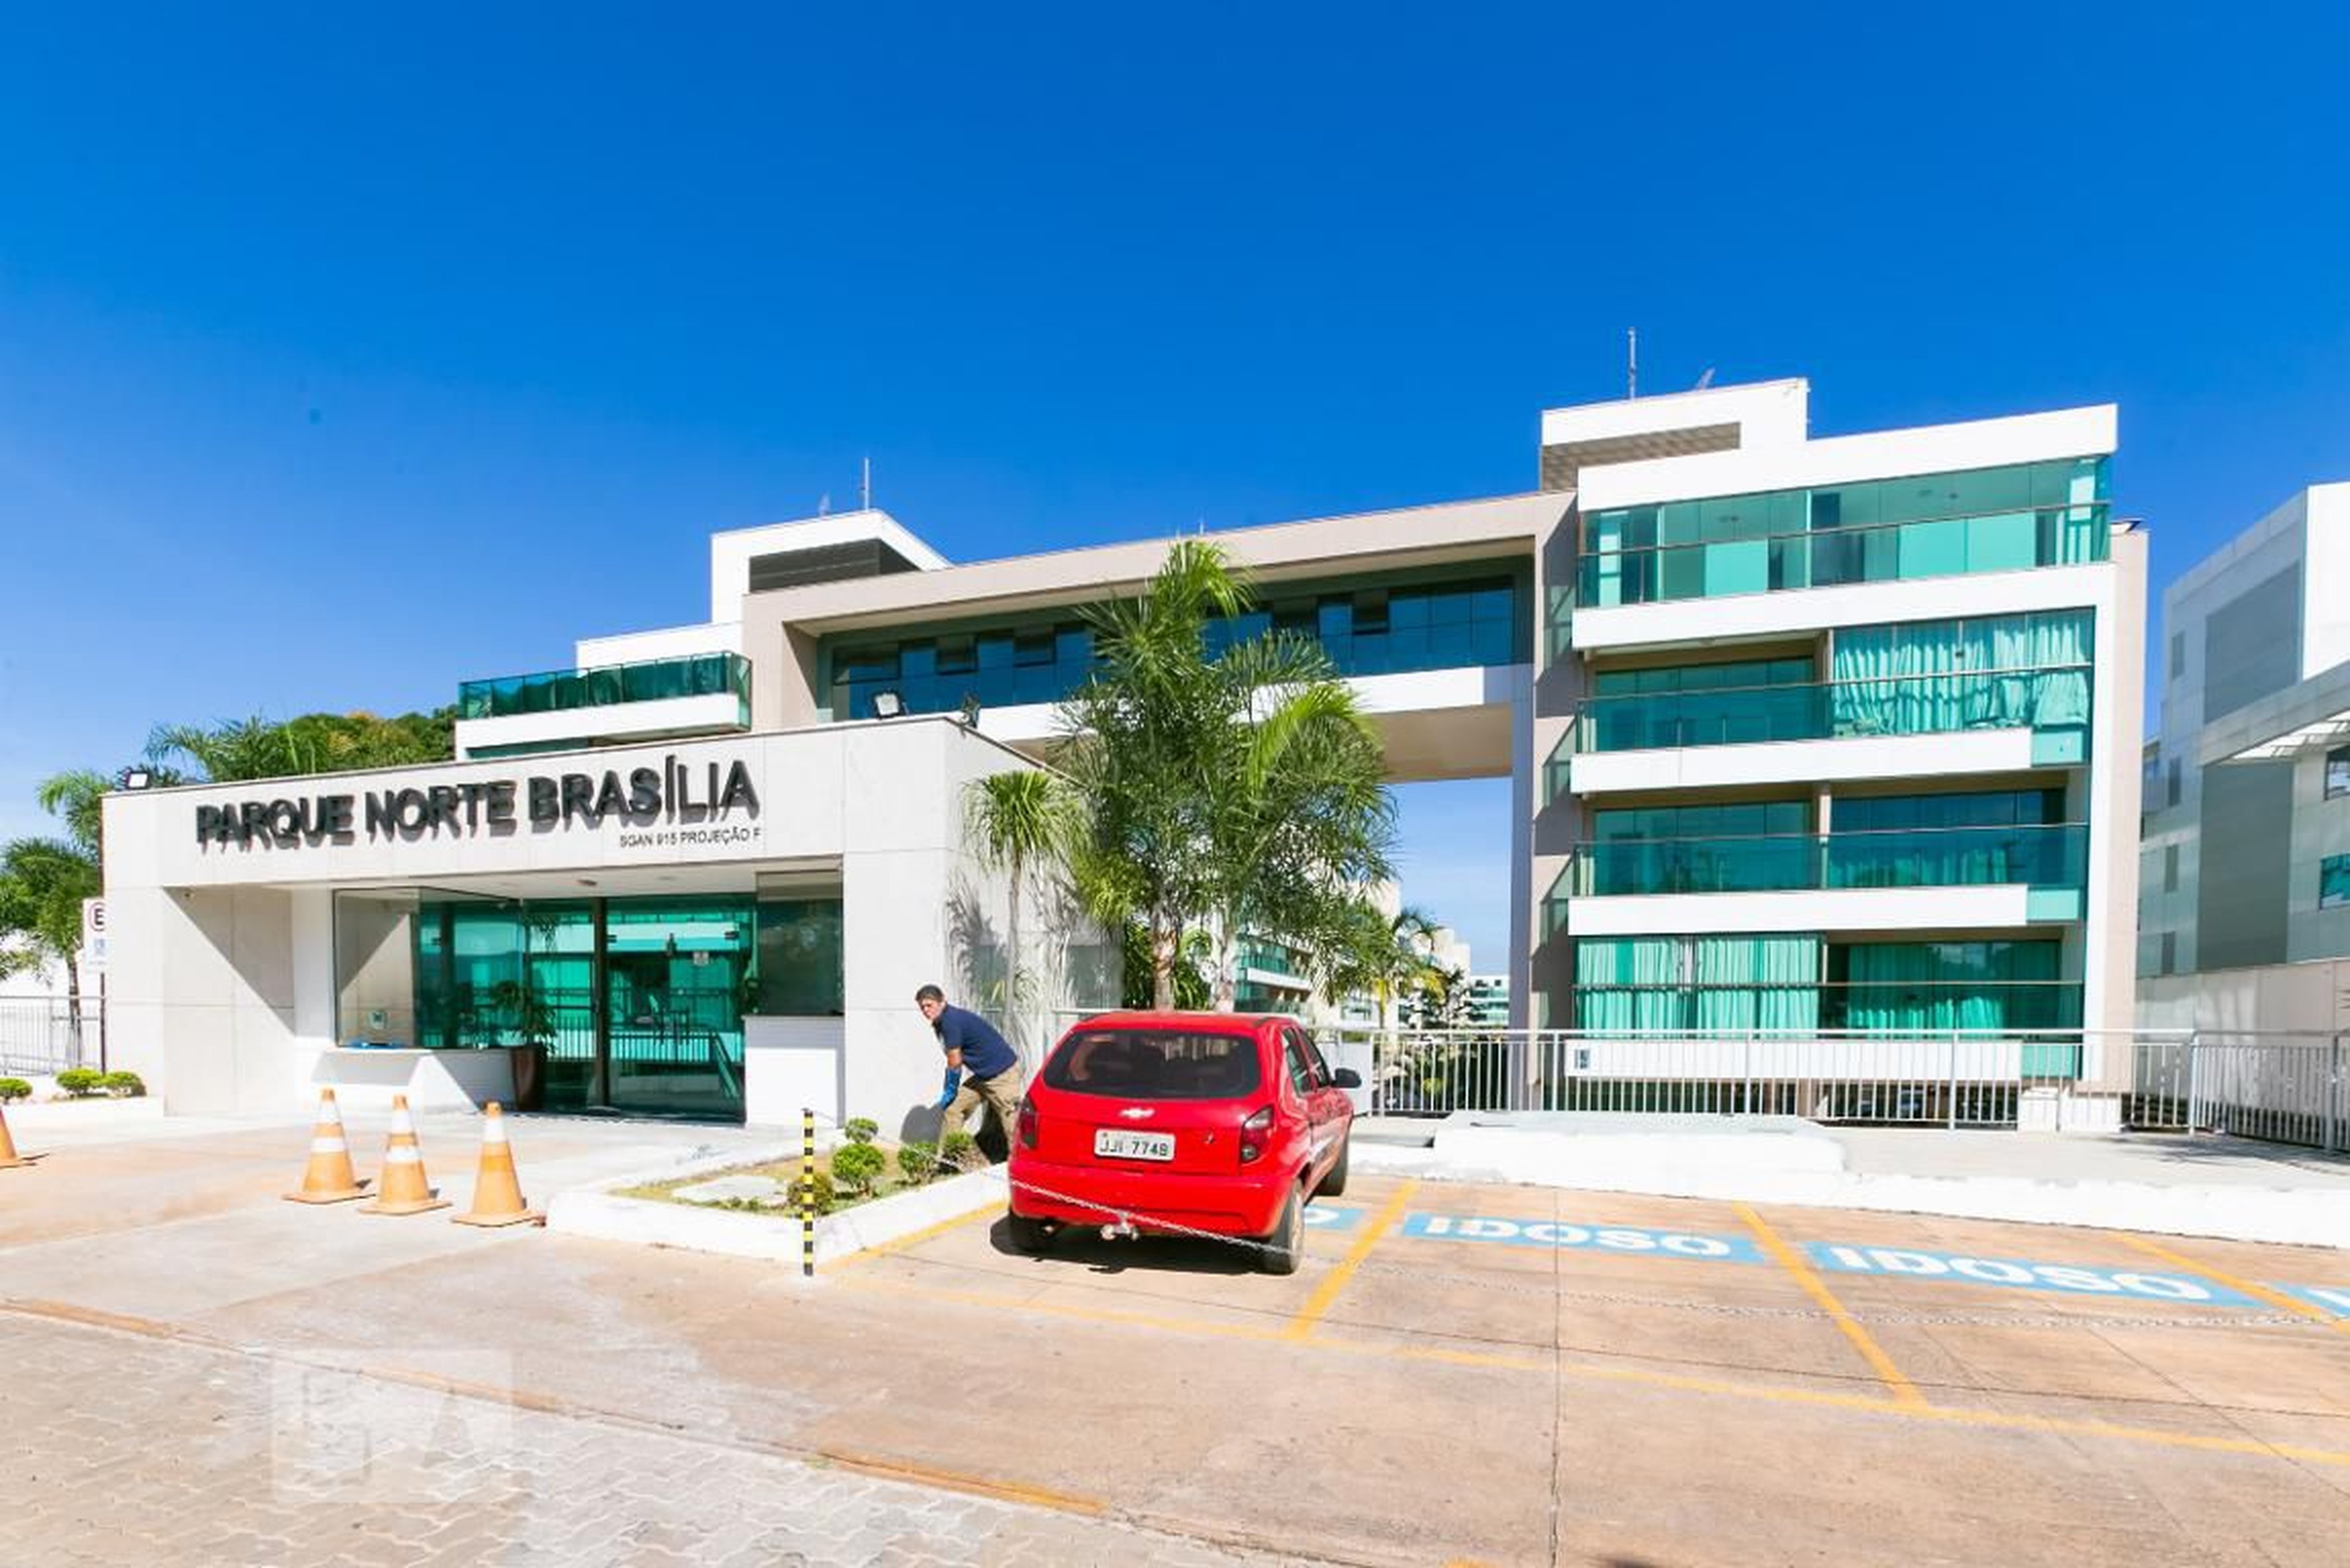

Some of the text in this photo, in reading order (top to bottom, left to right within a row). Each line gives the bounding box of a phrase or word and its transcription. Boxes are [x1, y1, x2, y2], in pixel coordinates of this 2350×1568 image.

[197, 755, 759, 851] PARQUE NORTE BRASÍLIA
[679, 826, 751, 845] PROJEÇÃO
[95, 908, 105, 925] E
[1424, 1217, 1731, 1256] IDOSO
[1829, 1246, 2212, 1300] IDOSO
